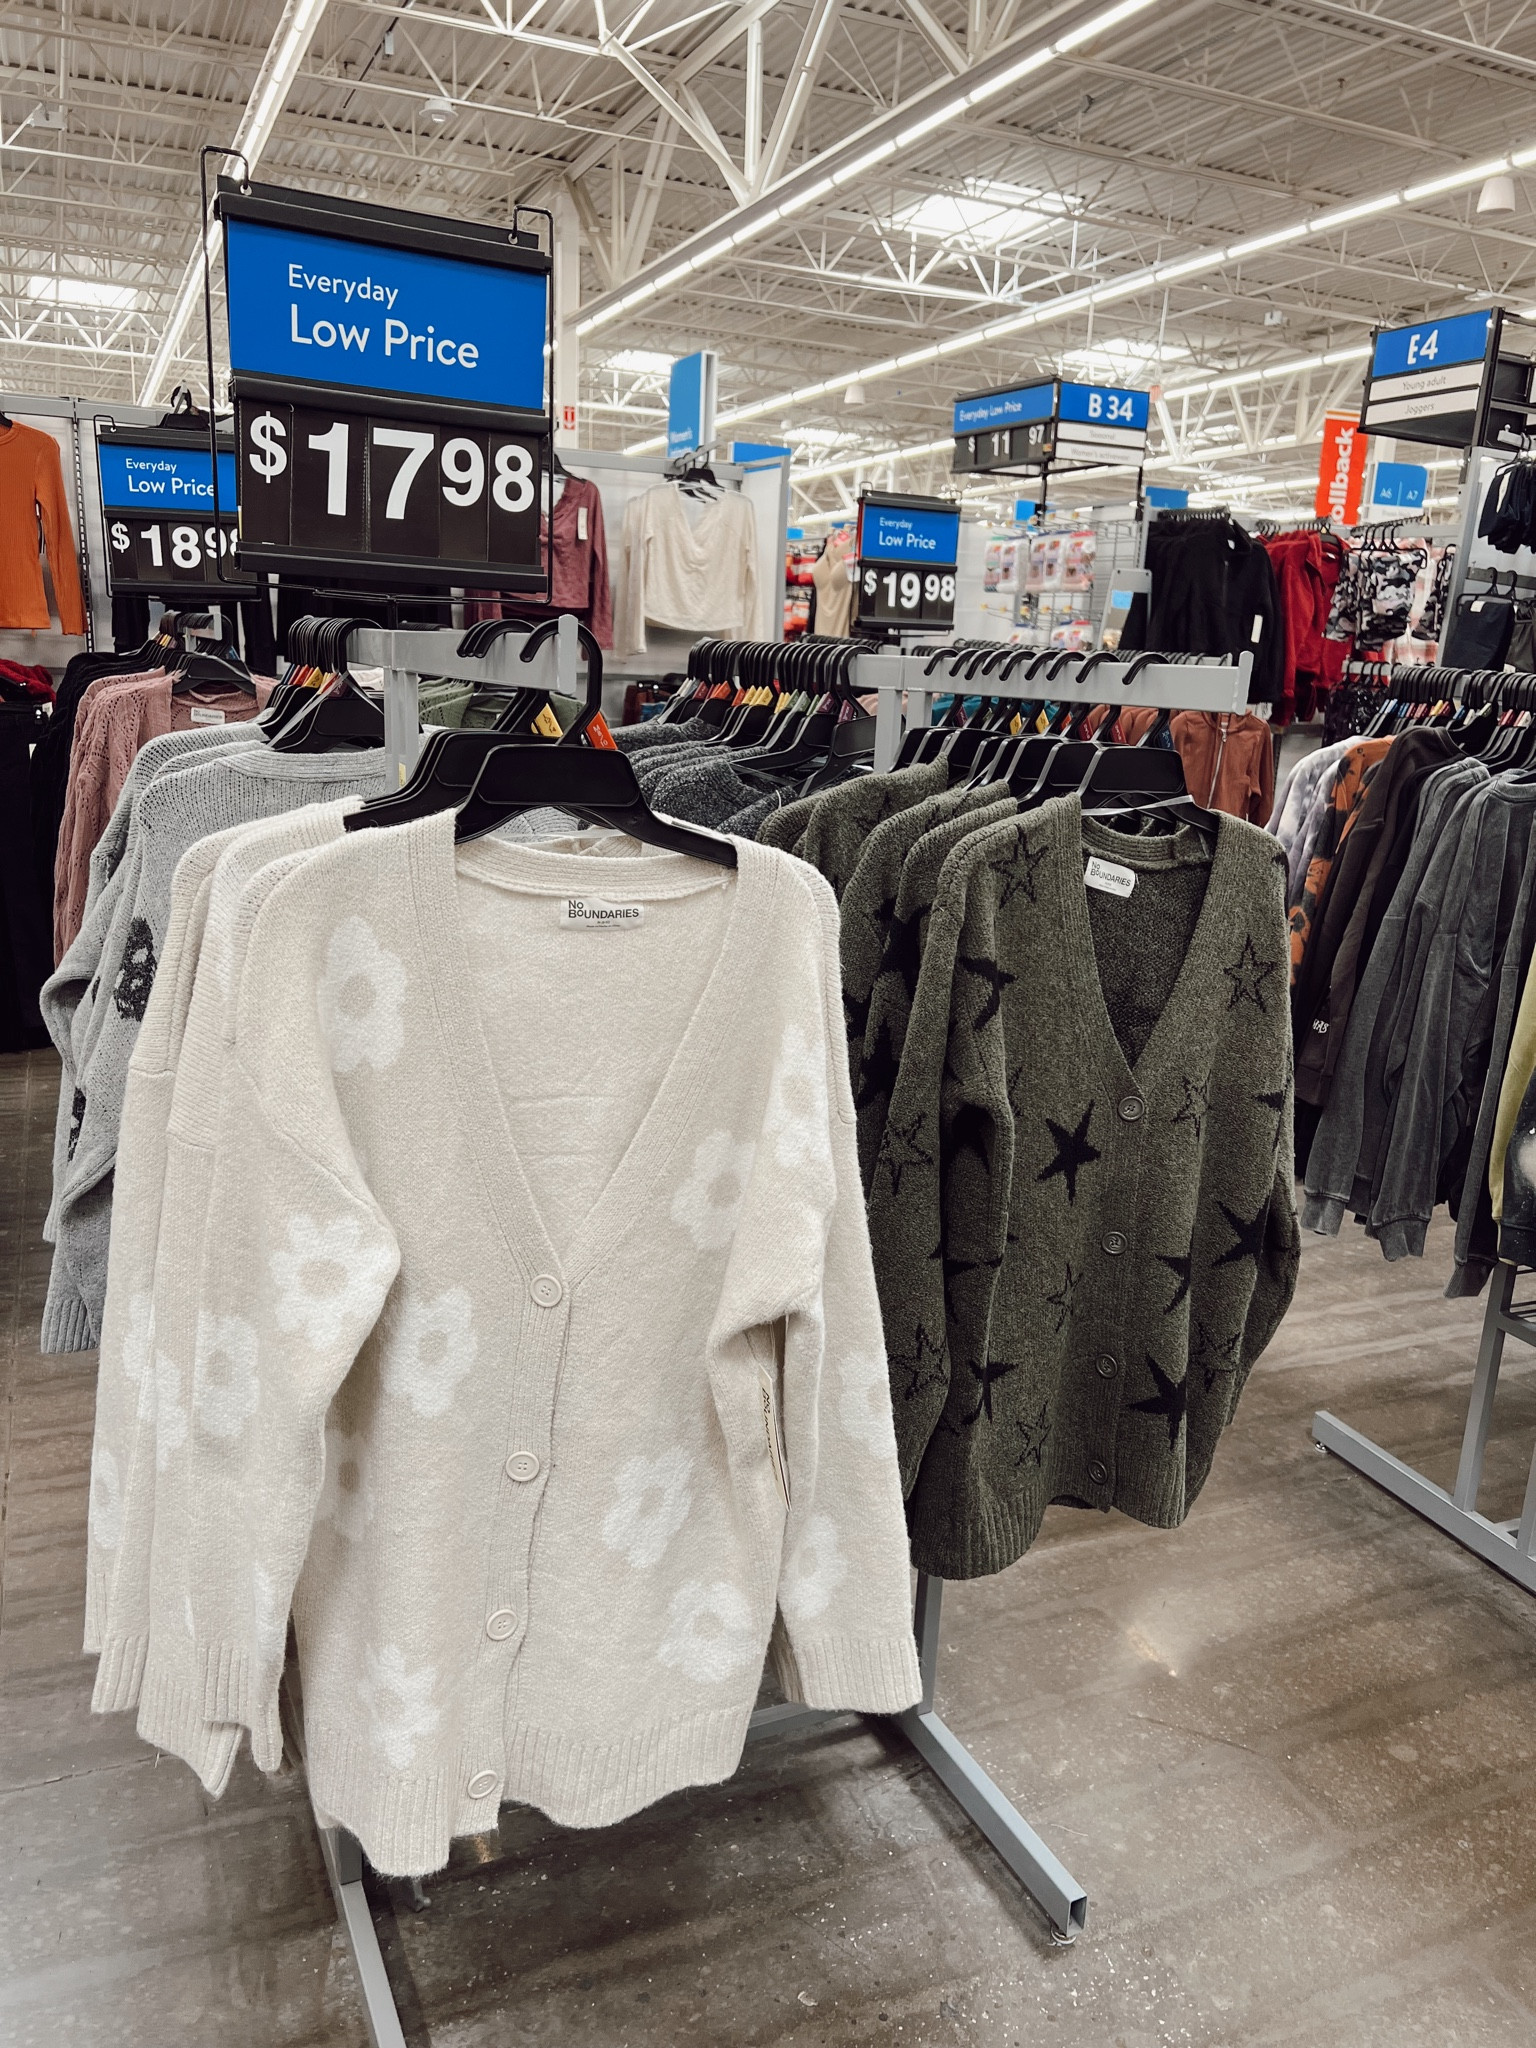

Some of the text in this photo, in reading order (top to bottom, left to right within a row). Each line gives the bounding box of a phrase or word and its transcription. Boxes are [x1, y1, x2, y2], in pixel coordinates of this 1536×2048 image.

[288, 263, 399, 310] Everyday
[290, 303, 479, 369] Low Price
[1407, 329, 1439, 365] E4
[1402, 376, 1446, 391] Young adult
[959, 400, 1022, 422] Everyday Low Price
[1088, 393, 1134, 422] B 34
[1404, 402, 1435, 416] Joggers
[125, 458, 177, 474] Everyday
[1328, 426, 1355, 525] ollback
[127, 474, 166, 494] Low
[879, 516, 913, 531] Everyday
[878, 530, 937, 550] Low Price
[1090, 869, 1132, 887] BOUNDARIES
[568, 899, 584, 910] No
[568, 908, 640, 919] BOUNDARIES
